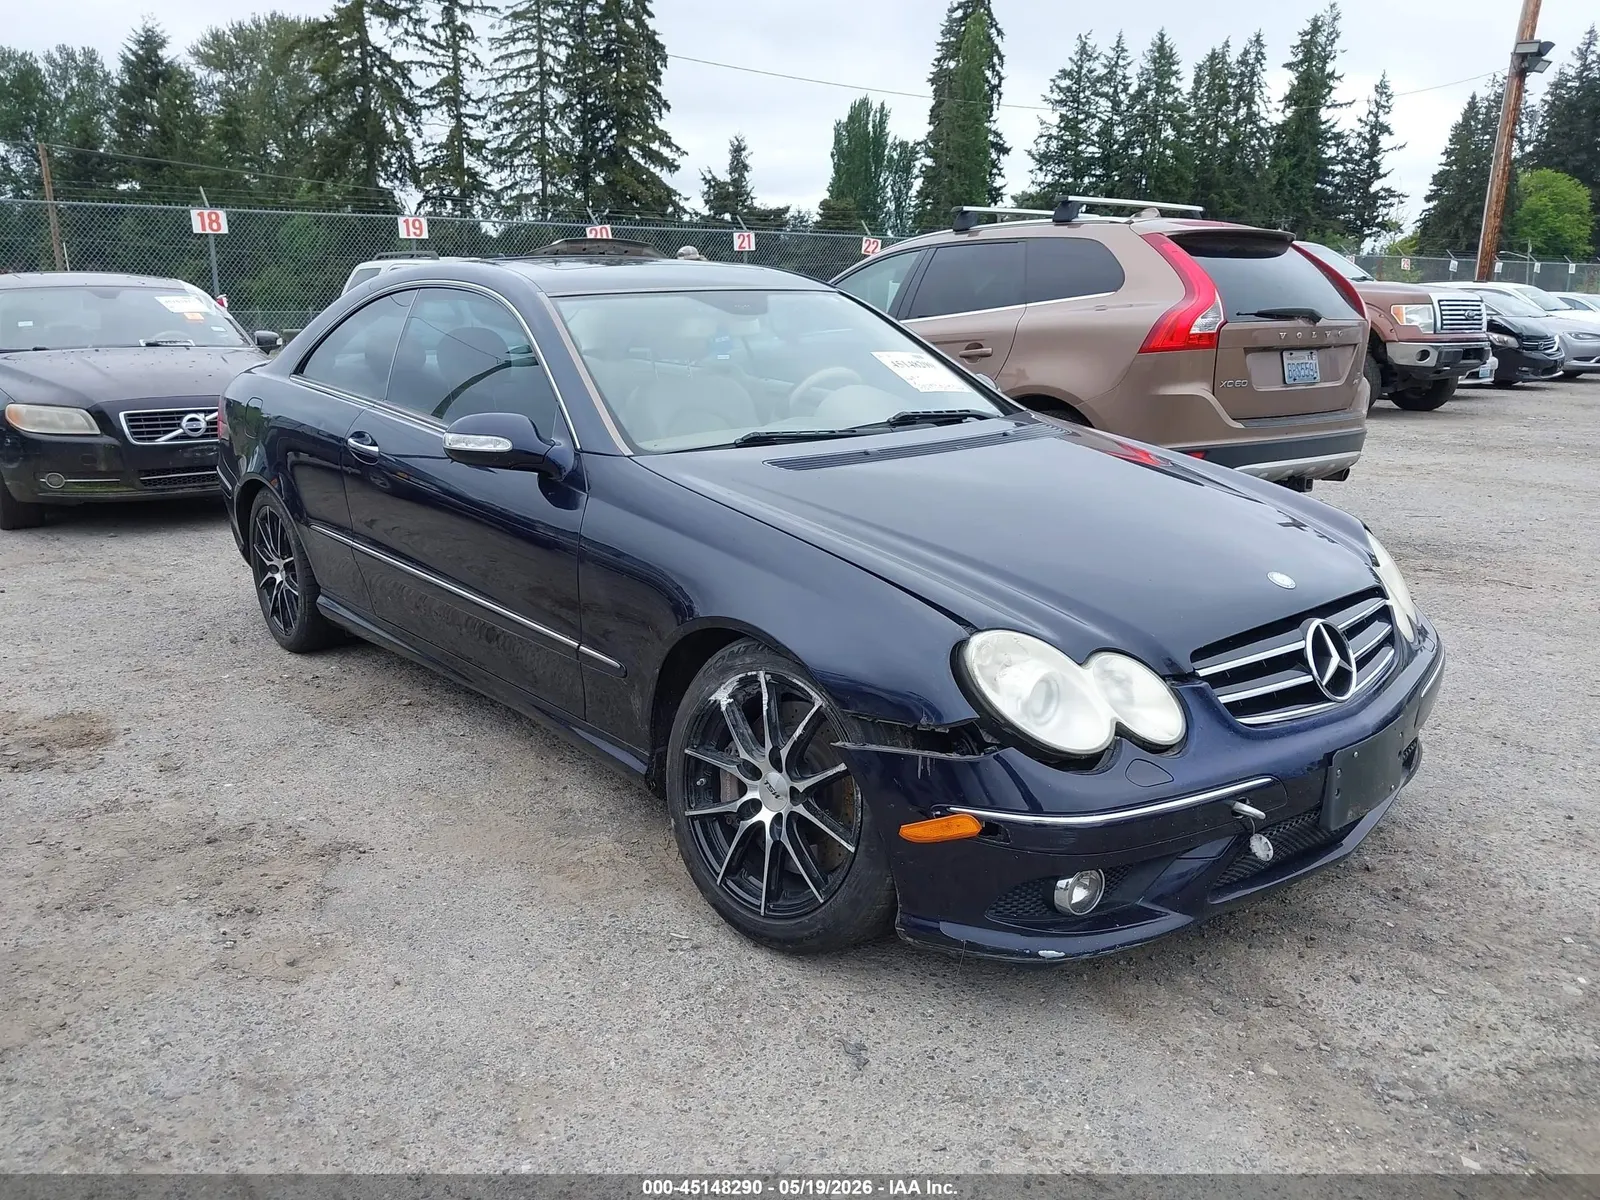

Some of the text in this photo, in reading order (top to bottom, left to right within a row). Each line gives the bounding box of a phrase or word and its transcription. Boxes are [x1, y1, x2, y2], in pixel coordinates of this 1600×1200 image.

[197, 211, 222, 232] 18
[403, 218, 423, 237] 19
[737, 233, 752, 249] 21
[864, 239, 879, 254] 22
[1279, 330, 1343, 340] VOLVO
[1219, 379, 1249, 388] XC60
